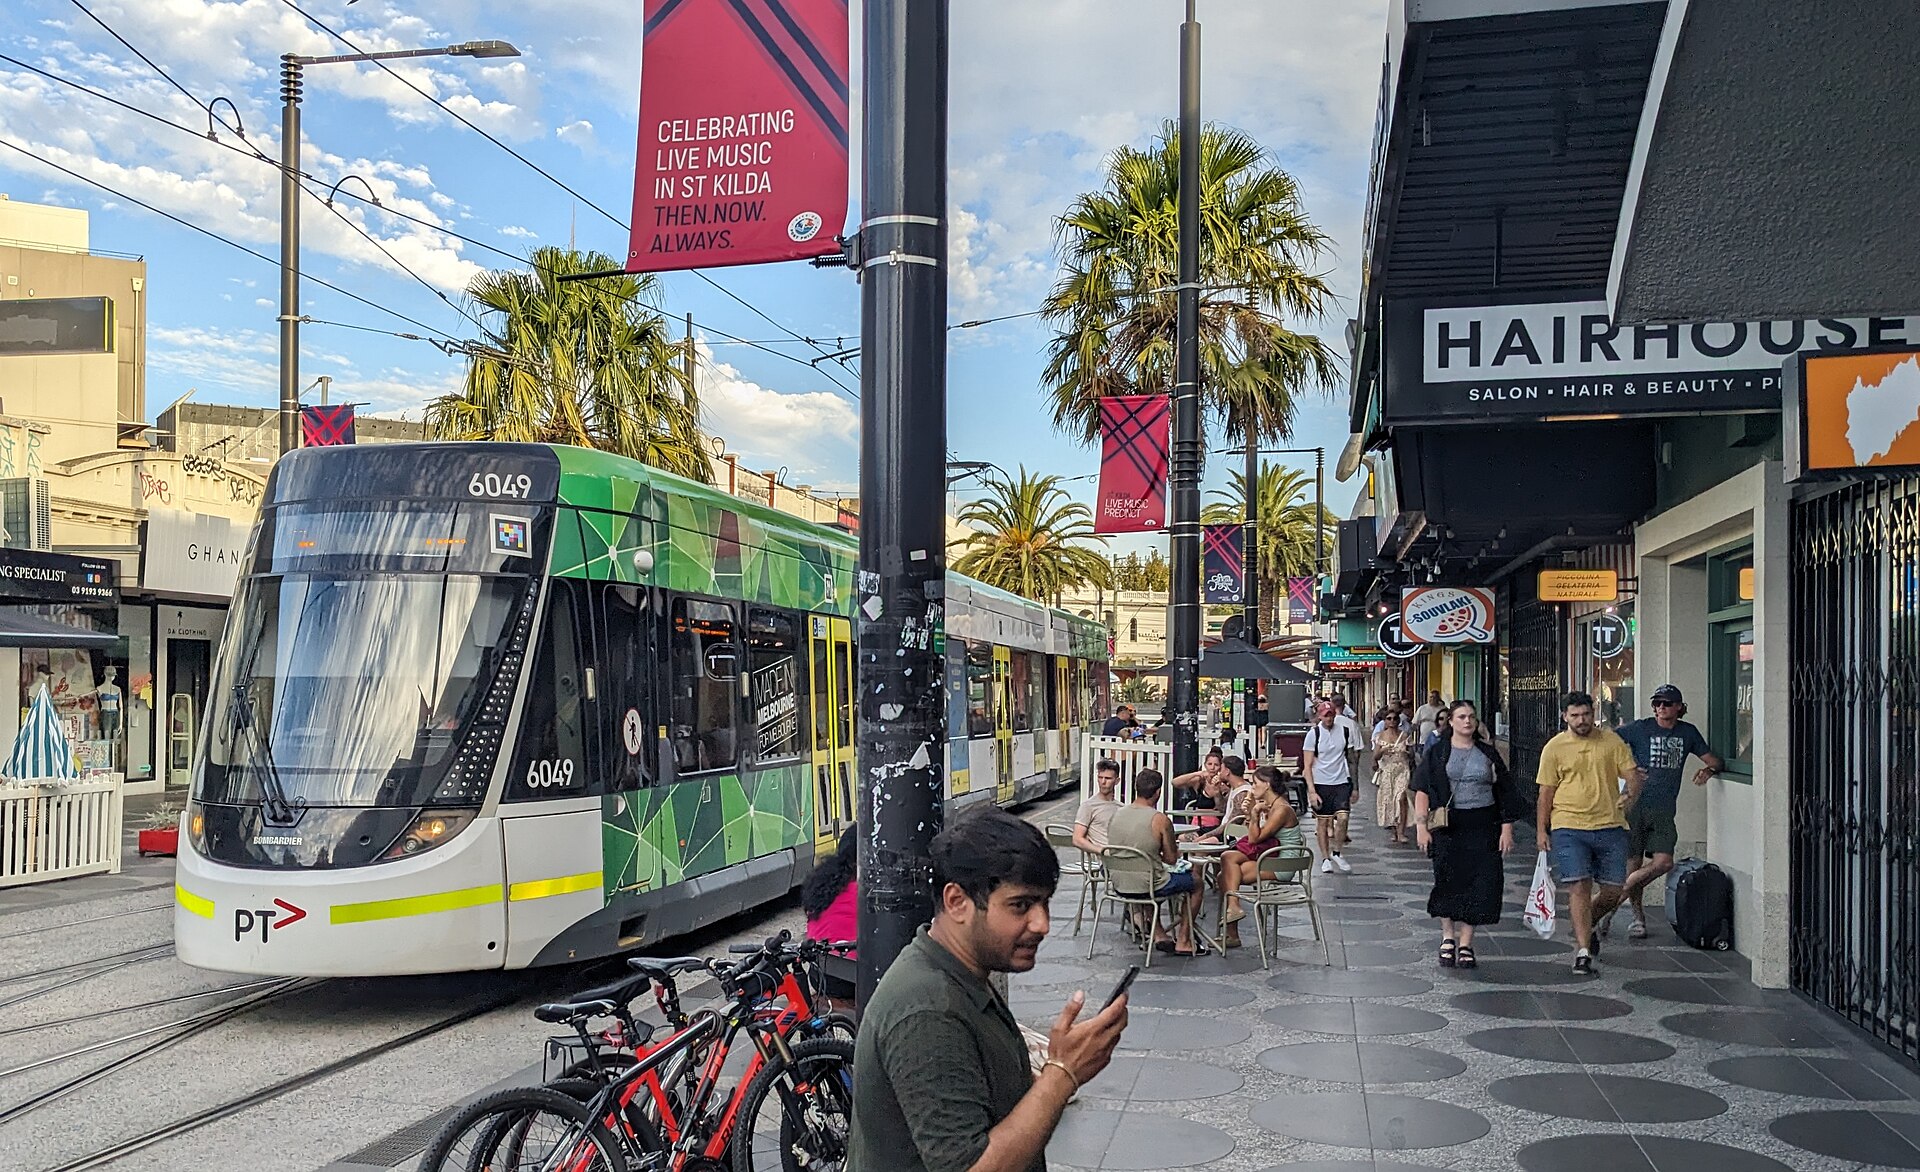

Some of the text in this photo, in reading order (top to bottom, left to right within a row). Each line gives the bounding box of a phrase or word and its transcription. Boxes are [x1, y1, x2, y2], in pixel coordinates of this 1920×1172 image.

[658, 109, 794, 143] CELEBRATING
[656, 141, 772, 171] LIVE MUSIC
[654, 171, 772, 199] IN ST KILDA
[650, 230, 735, 254] ALWAYS.
[1437, 315, 1907, 369] HAIRHOUSE
[1469, 386, 1538, 401] SALON
[1563, 383, 1613, 397] HAIR
[1624, 382, 1636, 395] &
[1647, 378, 1734, 394] BEAUTY
[468, 472, 532, 499] 6049
[1104, 508, 1142, 518] PRECINCT
[1105, 499, 1149, 508] LIVE MUSIC
[188, 544, 239, 565] GHAN
[14, 566, 66, 582] SPECIALIST
[72, 586, 80, 595] 03
[81, 587, 97, 596] 9193
[1412, 591, 1455, 609] KINGS
[1410, 595, 1472, 624] SOUVLAKI
[755, 666, 783, 707] MADE
[757, 692, 795, 726] MELBOURNE
[526, 758, 574, 788] 6049
[253, 836, 303, 846] BOMBARDIER
